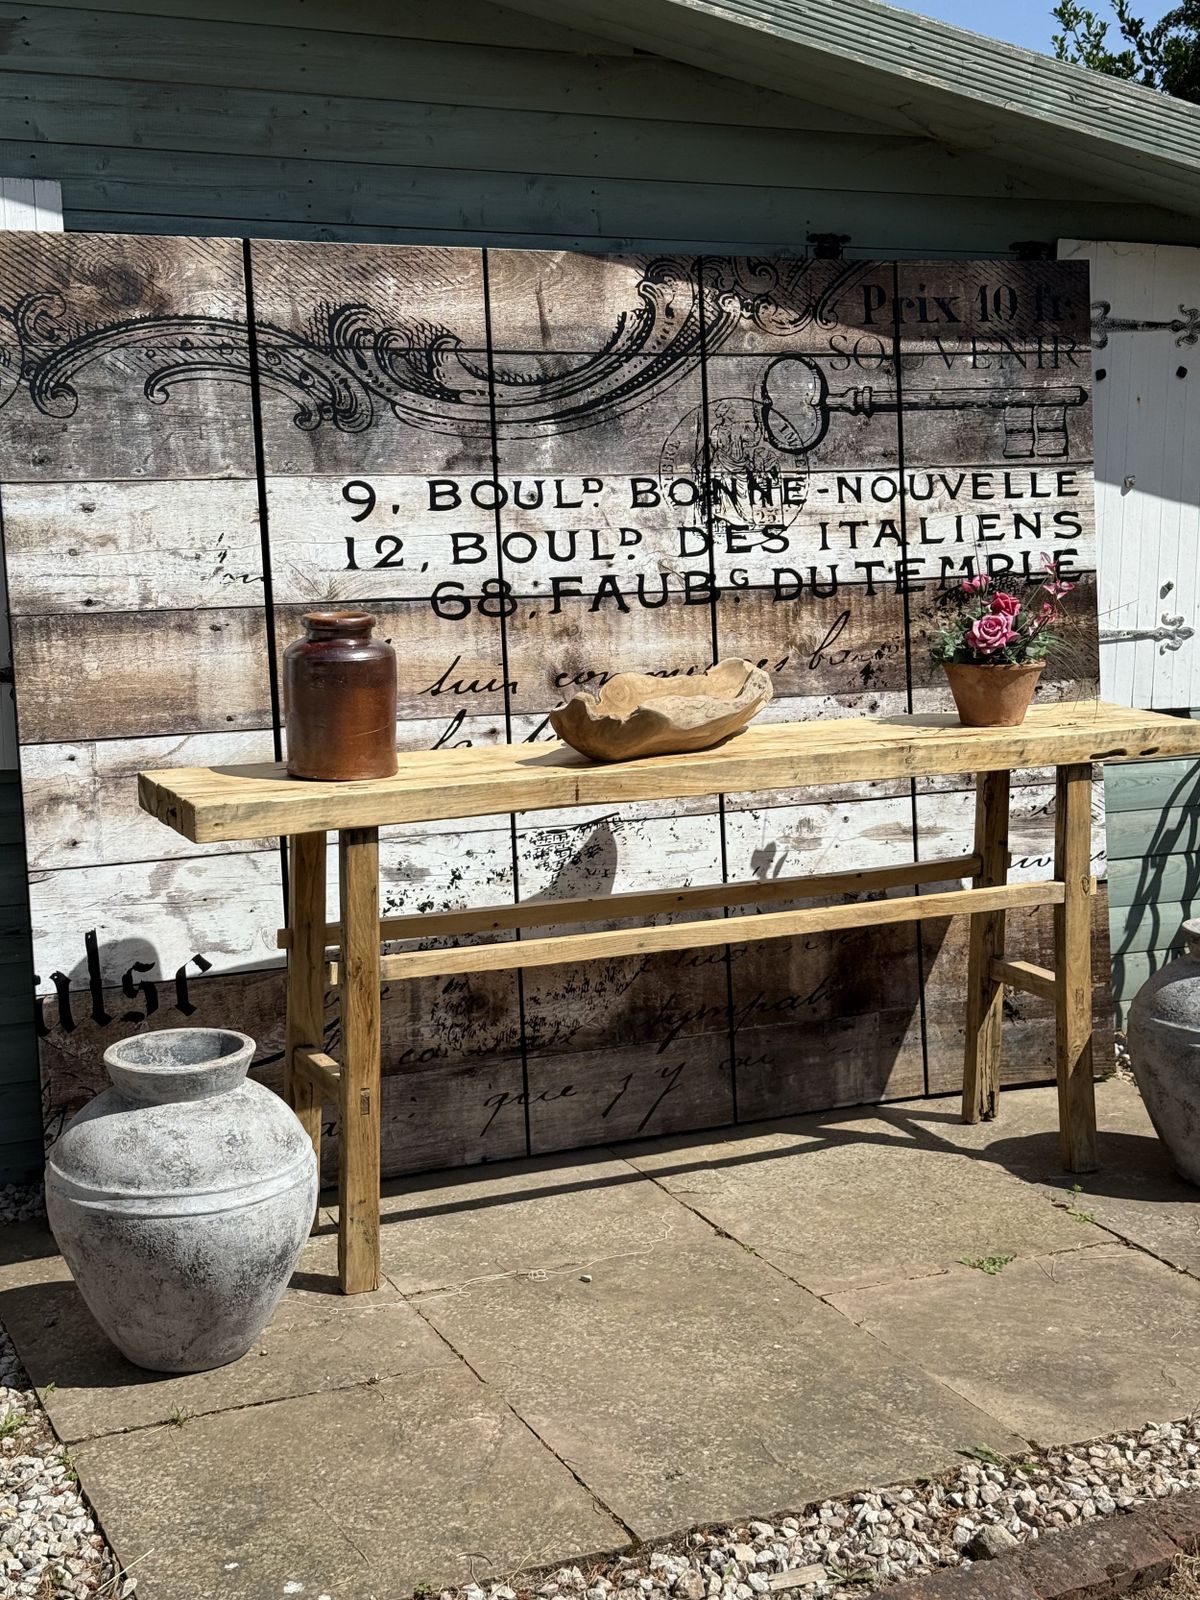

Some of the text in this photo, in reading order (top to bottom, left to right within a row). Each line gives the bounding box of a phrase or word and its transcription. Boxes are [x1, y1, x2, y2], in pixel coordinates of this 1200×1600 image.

[861, 283, 962, 325] Prix
[974, 283, 1018, 323] 10
[828, 334, 1082, 371] SOUVENIR
[678, 524, 790, 558] DES
[819, 511, 1083, 550] ITALIENS
[772, 564, 839, 604] DU
[855, 548, 1082, 596] TEMPLE
